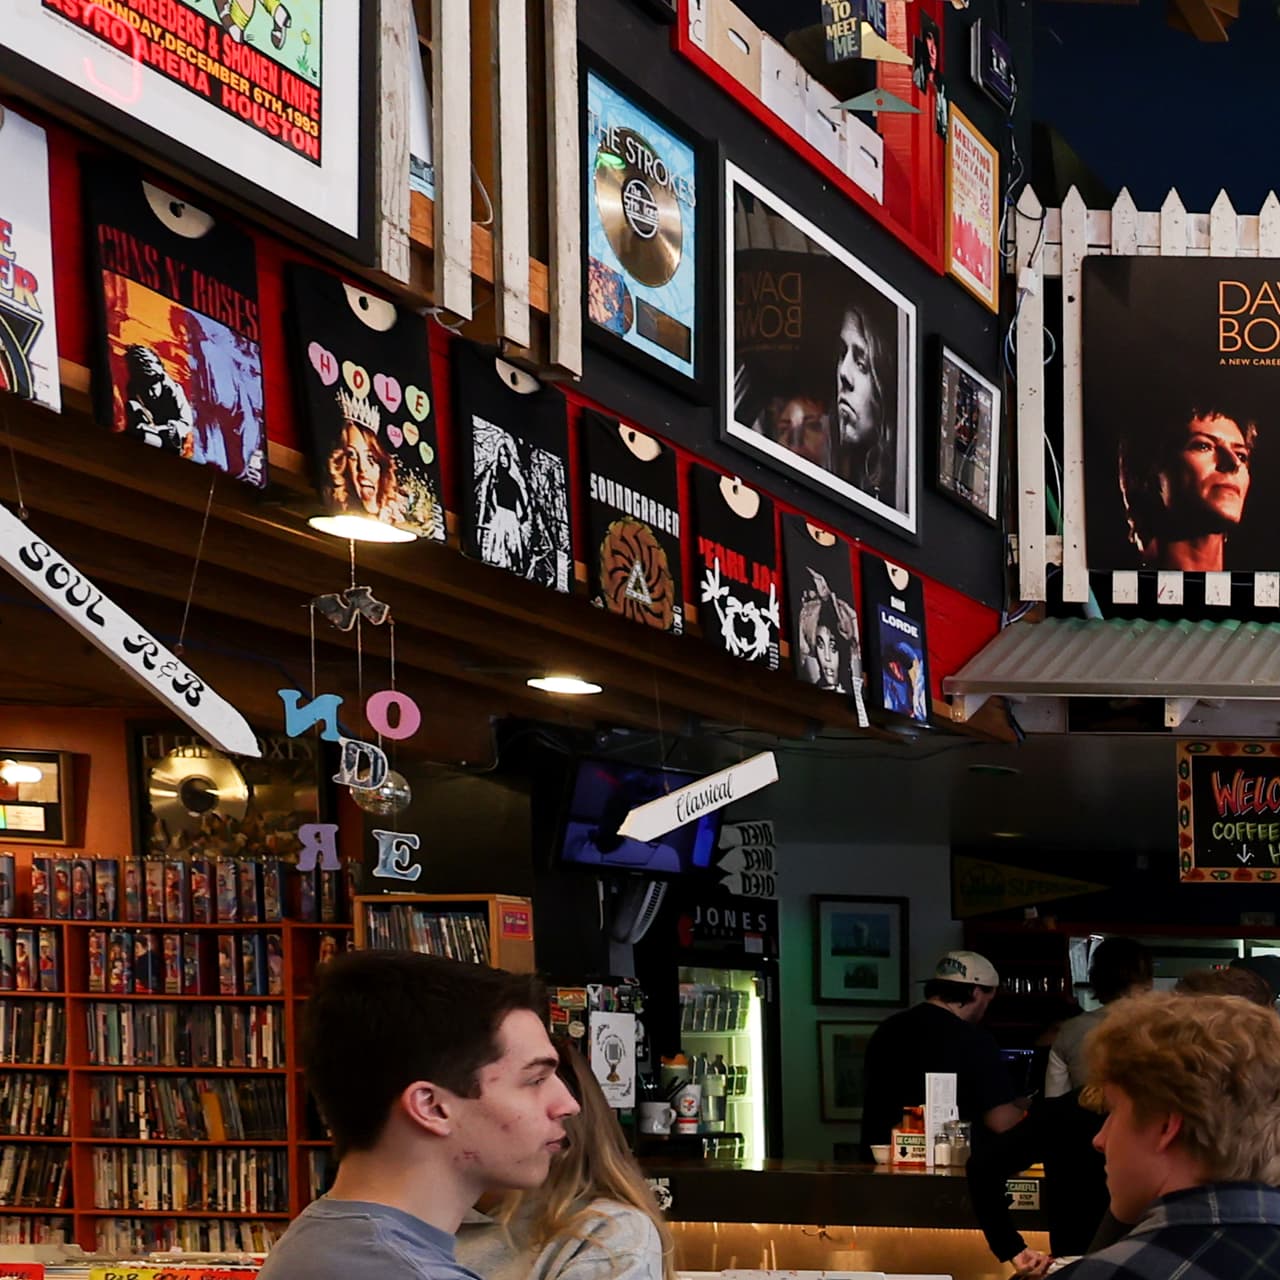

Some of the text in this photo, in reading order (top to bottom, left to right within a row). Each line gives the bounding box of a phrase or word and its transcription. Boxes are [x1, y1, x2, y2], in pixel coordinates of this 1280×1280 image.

[827, 17, 858, 38] MEET
[834, 34, 858, 58] ME
[139, 38, 319, 161] ARENA HOUSTON
[222, 37, 279, 92] SHONEN
[281, 68, 320, 119] KNIFE
[626, 137, 697, 208] STROKES
[193, 270, 258, 342] ROSES
[1220, 358, 1226, 366] A
[1229, 358, 1250, 366] NEW
[590, 473, 680, 539] SOUNDGARDEN
[19, 540, 108, 628] SOUL
[881, 611, 918, 638] LORDE
[676, 773, 732, 822] Classical
[1212, 820, 1280, 840] COFFEE
